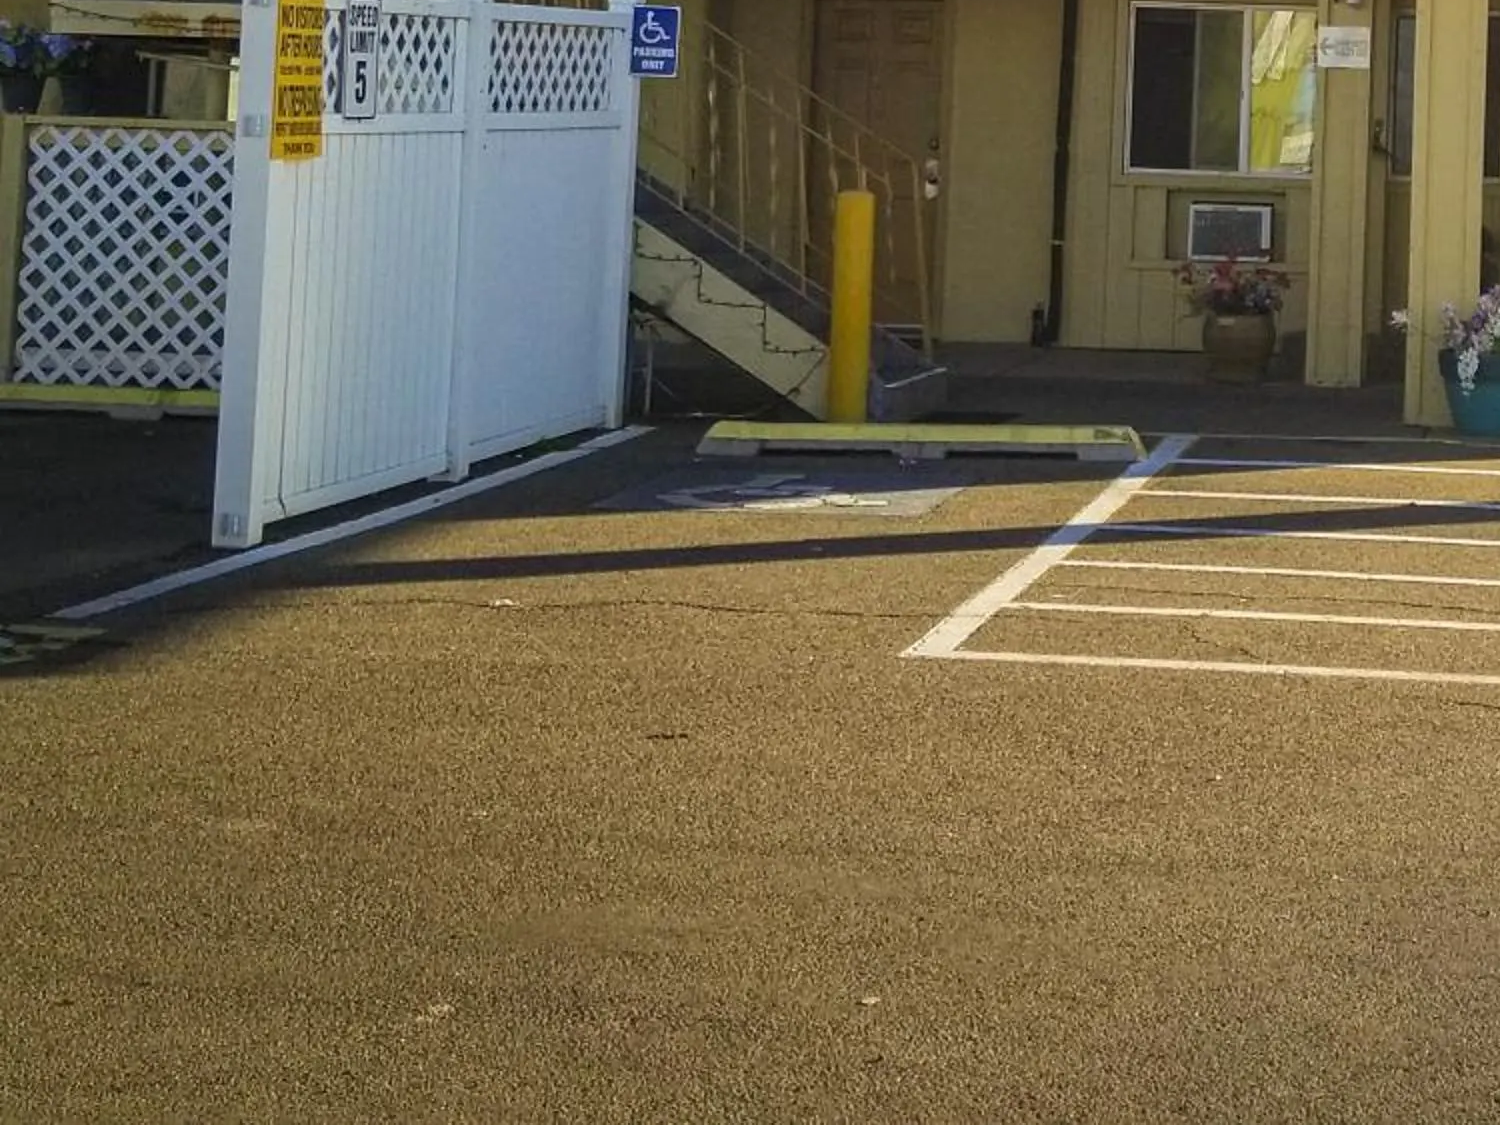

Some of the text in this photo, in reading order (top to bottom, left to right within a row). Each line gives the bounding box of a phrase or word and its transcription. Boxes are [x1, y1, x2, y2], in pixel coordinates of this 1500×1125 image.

[350, 4, 378, 28] SPEED
[350, 30, 376, 54] LIMIT
[355, 60, 367, 104] 5
